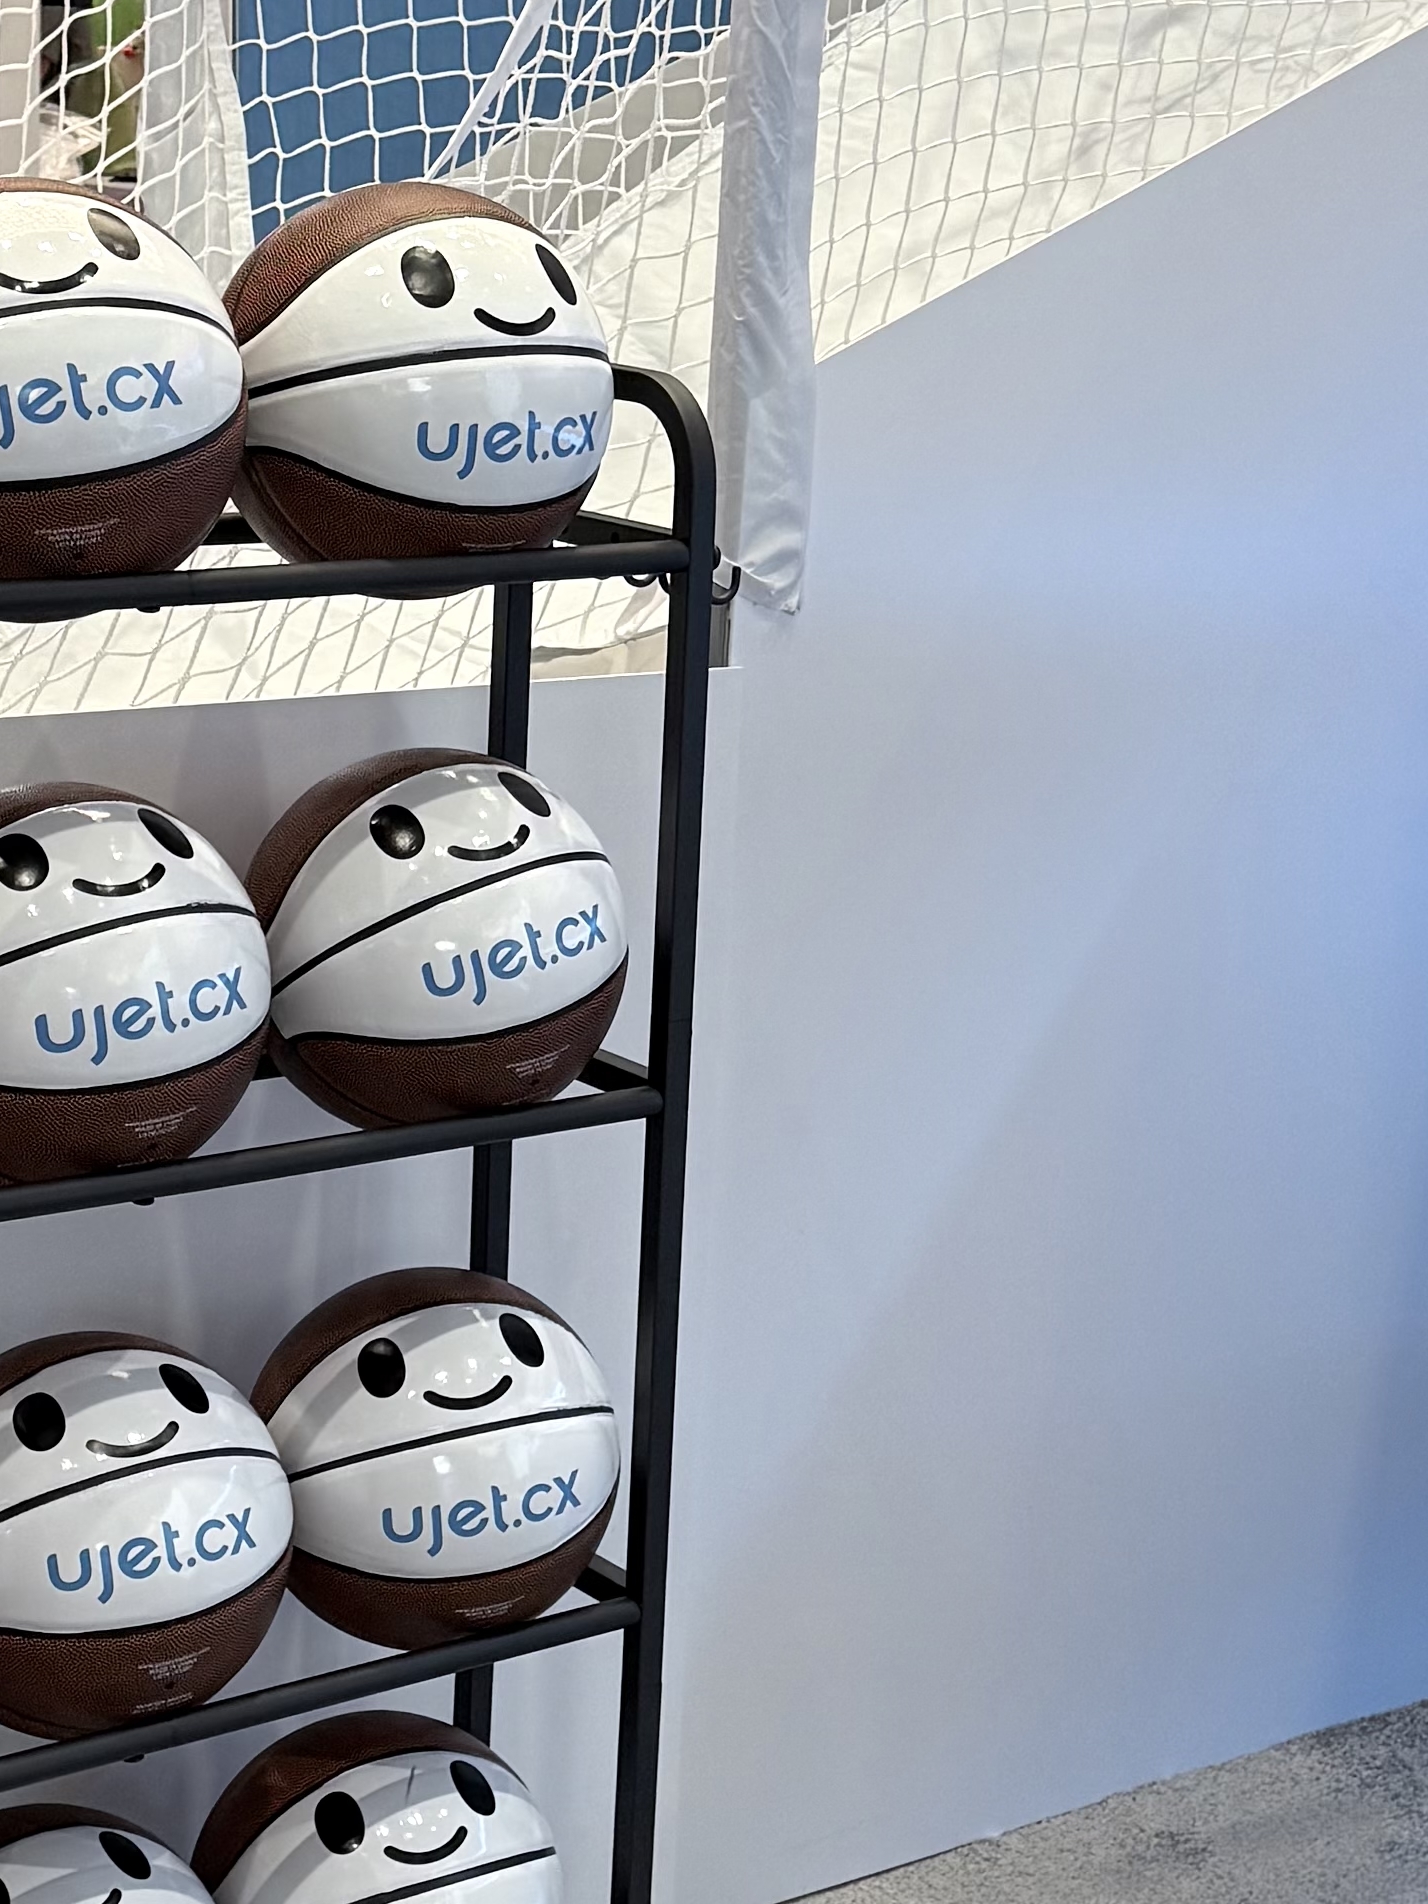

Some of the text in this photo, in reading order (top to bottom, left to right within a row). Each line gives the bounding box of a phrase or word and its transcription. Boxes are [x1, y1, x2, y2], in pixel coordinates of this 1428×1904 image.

[416, 410, 597, 479] ujet.cx
[421, 904, 607, 1005] ujet.cx
[34, 966, 247, 1065] ujet.cx
[46, 1507, 258, 1605] ujet.cx
[381, 1471, 582, 1558] ujet.cx
